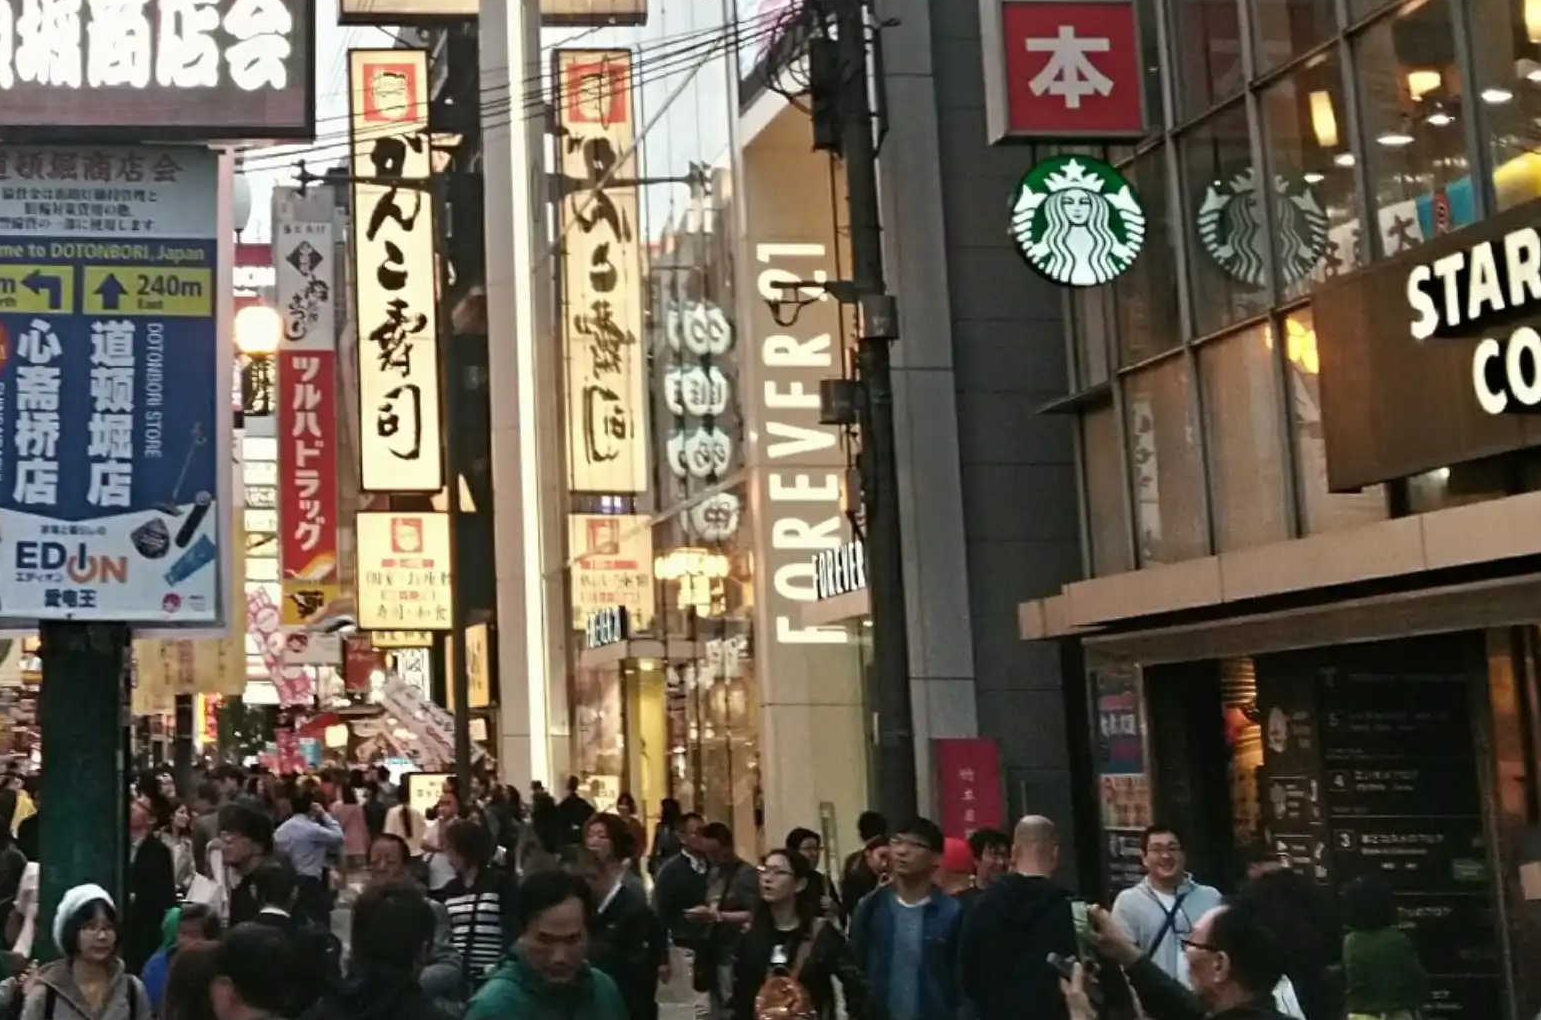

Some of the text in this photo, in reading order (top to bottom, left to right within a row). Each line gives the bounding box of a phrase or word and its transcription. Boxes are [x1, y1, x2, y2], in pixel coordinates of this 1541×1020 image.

[1025, 25, 1114, 109] 本
[28, 242, 46, 257] to
[156, 244, 205, 266] Japan
[137, 273, 202, 297] 240m
[12, 319, 62, 506] 心斎橋店
[87, 320, 137, 507] 道頓堀店
[144, 322, 164, 458] DOTONBORI STORE
[291, 356, 326, 552] ツルハドラッグ
[16, 541, 128, 584] EDION
